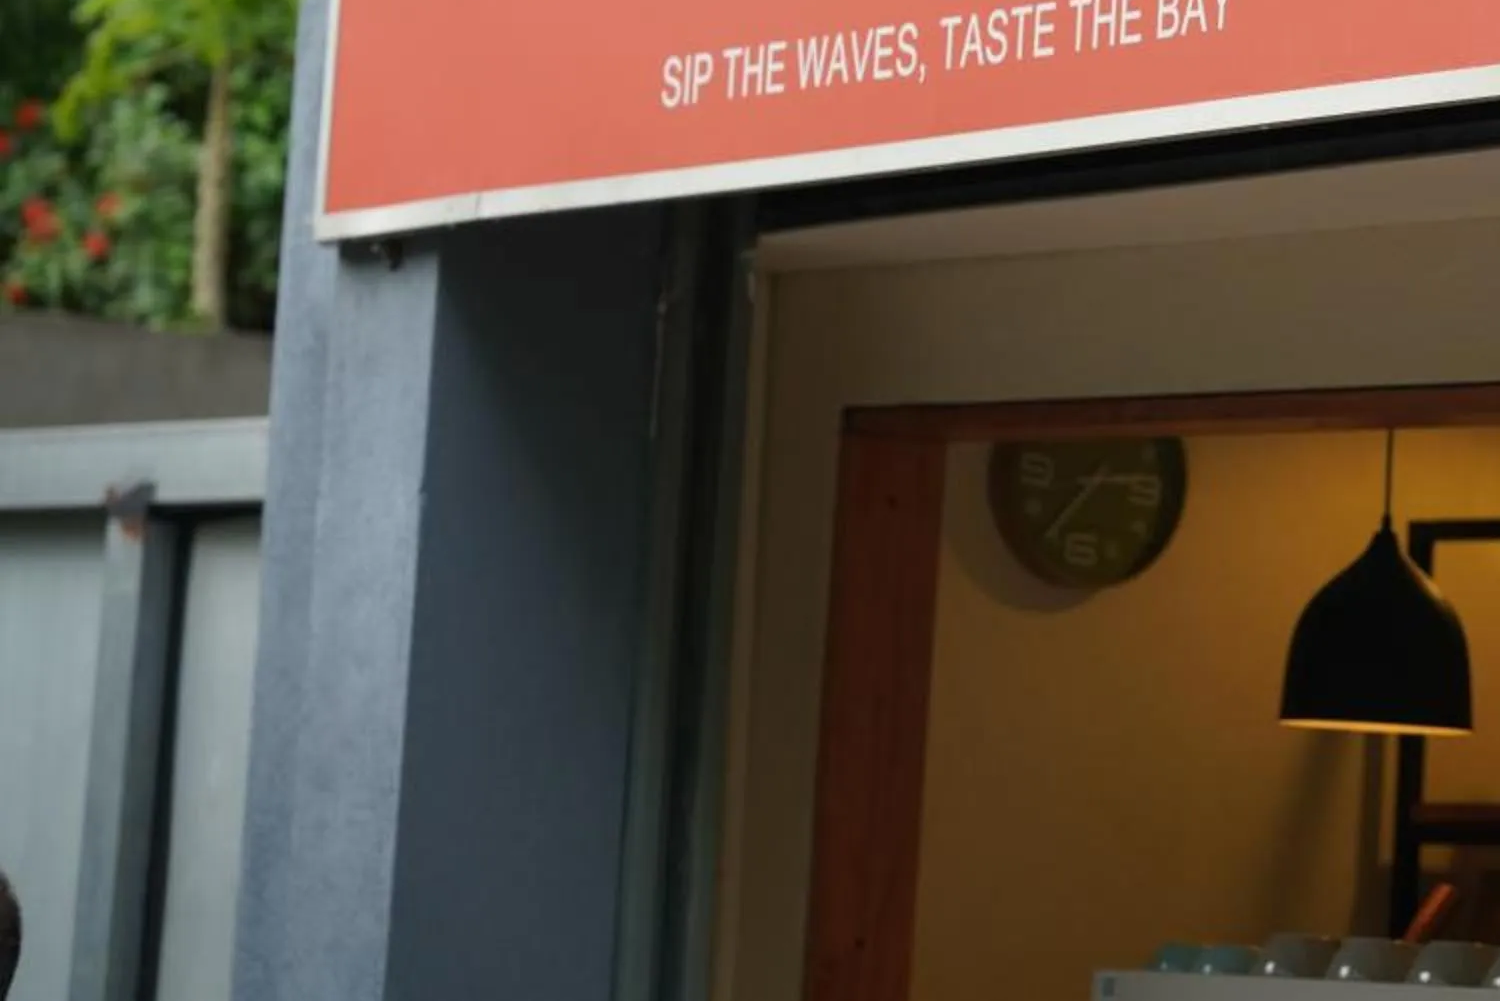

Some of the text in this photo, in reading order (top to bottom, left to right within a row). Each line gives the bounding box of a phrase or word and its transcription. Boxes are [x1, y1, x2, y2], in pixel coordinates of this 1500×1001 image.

[660, 52, 714, 108] SIP
[723, 41, 787, 99] THE
[797, 23, 927, 90] WAVES,
[940, 2, 1056, 70] TASTE
[1020, 452, 1054, 488] 9
[1064, 531, 1098, 567] 6
